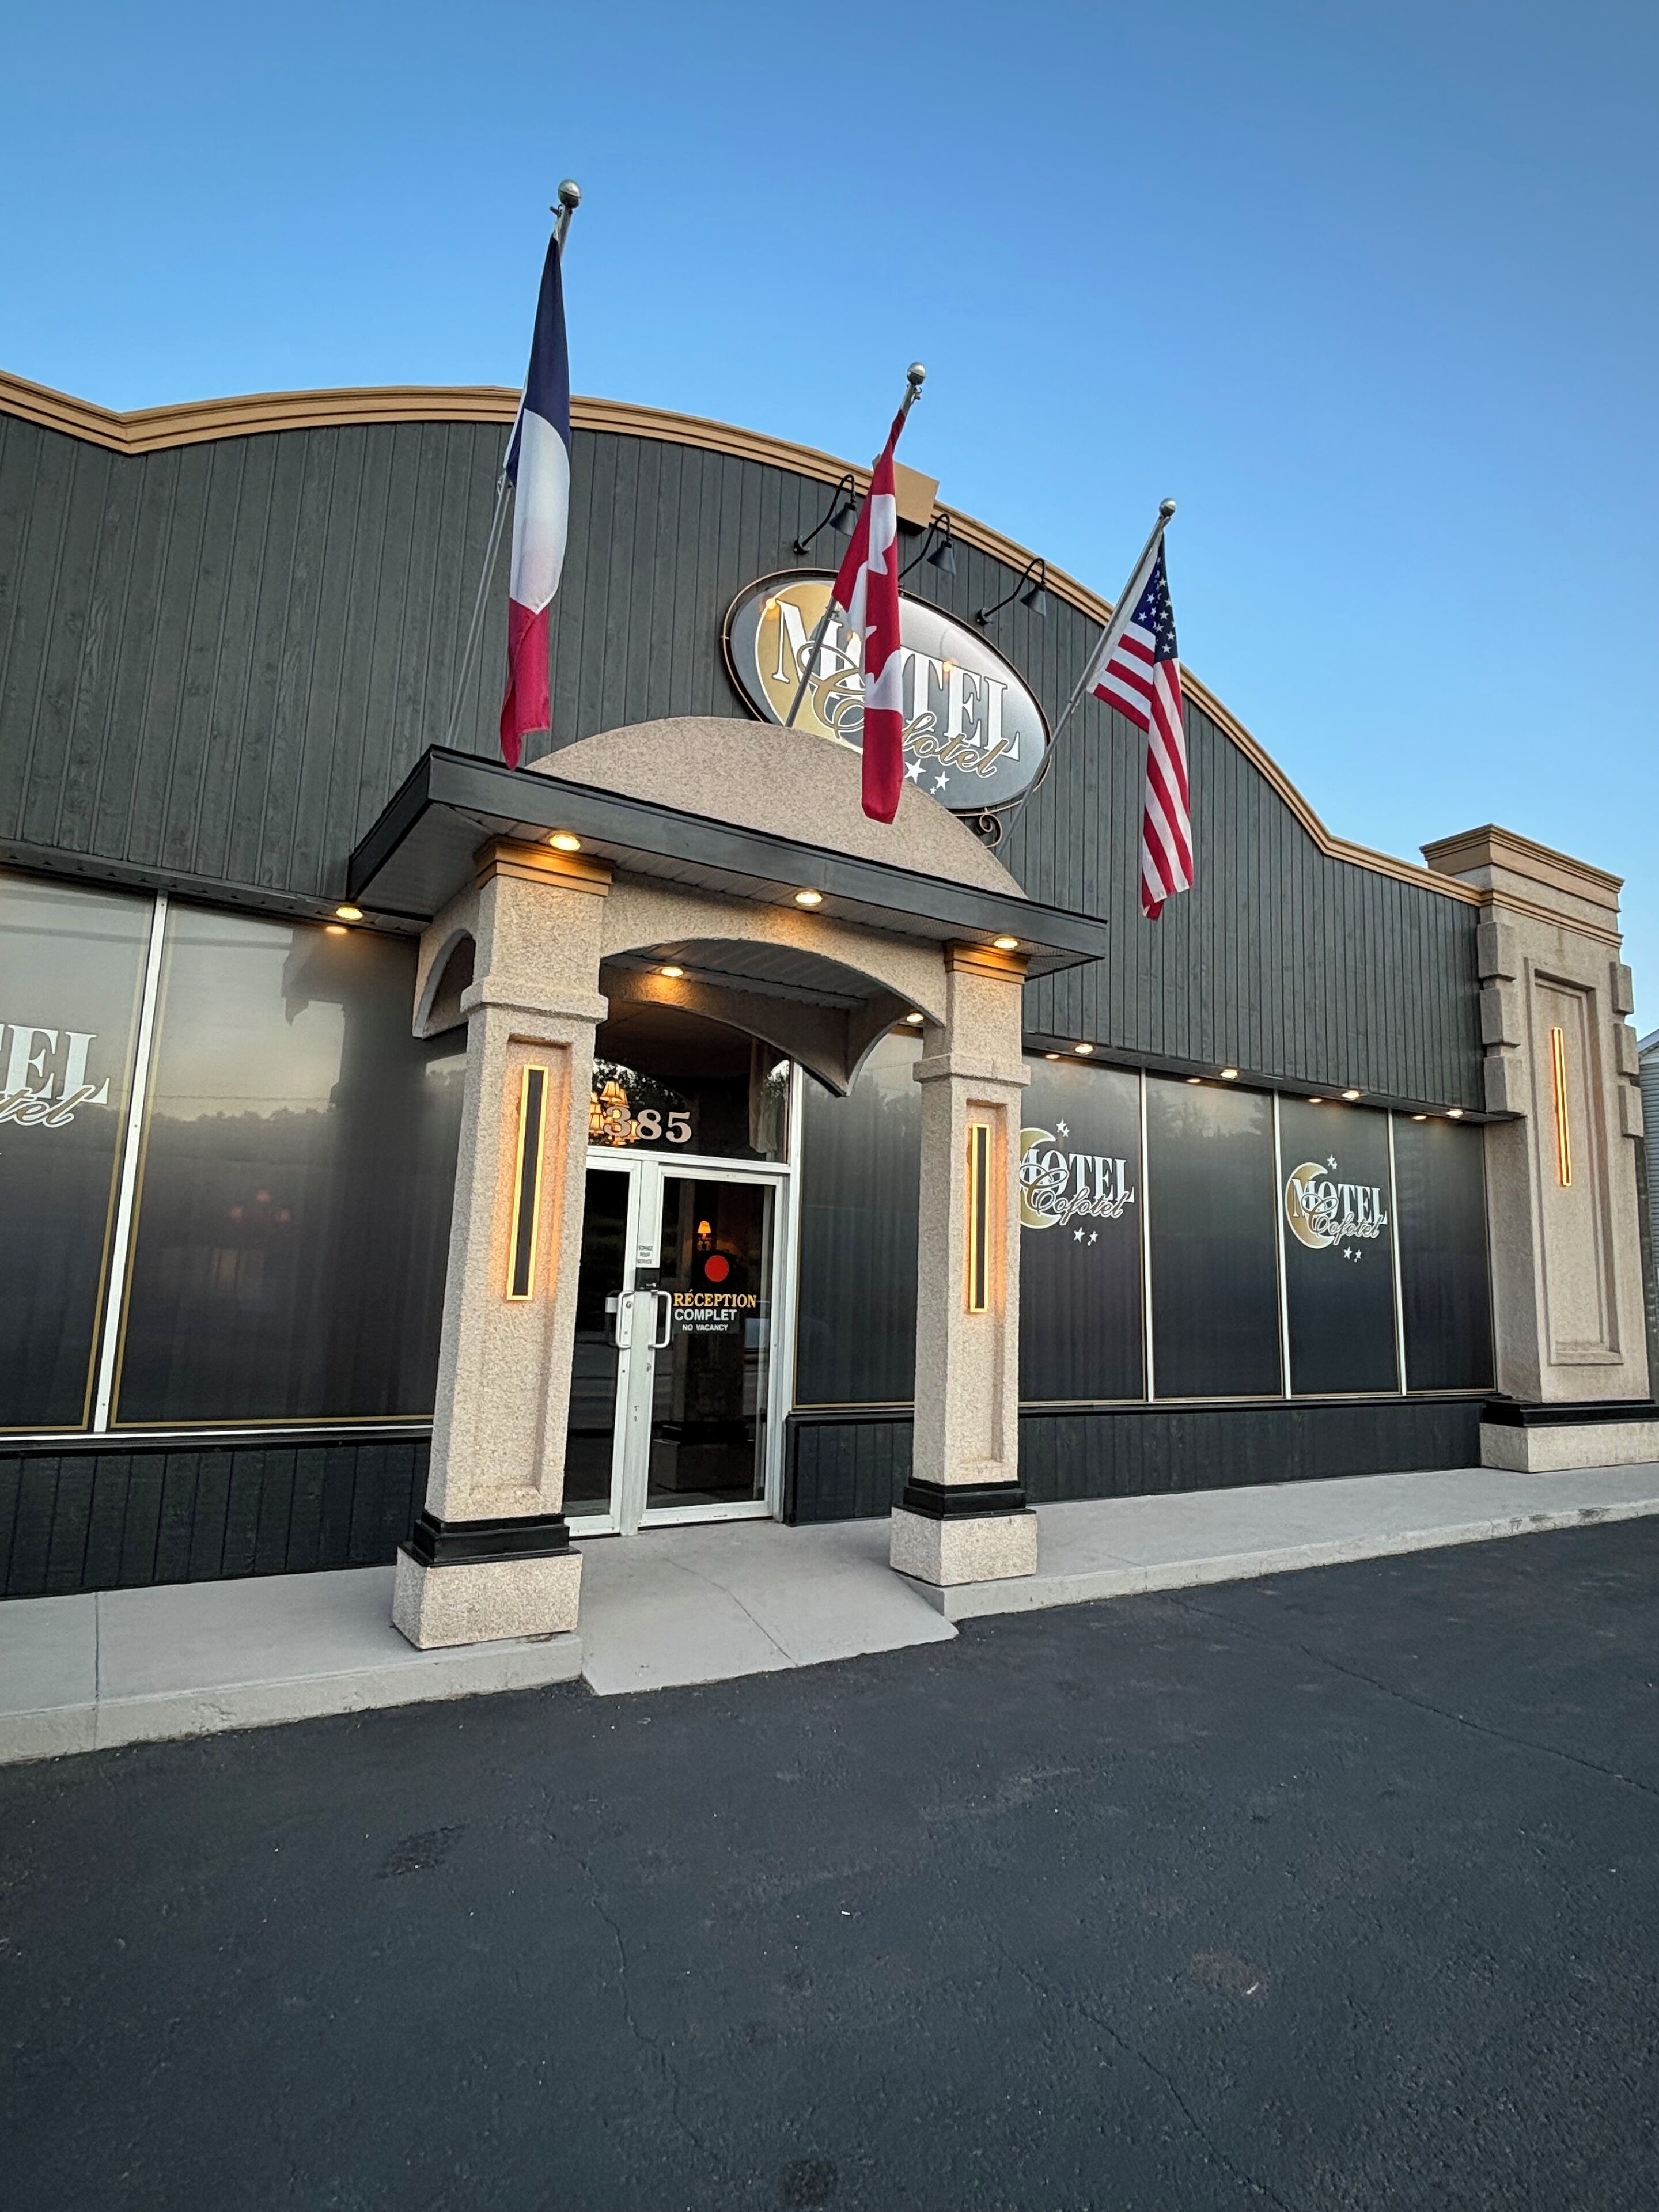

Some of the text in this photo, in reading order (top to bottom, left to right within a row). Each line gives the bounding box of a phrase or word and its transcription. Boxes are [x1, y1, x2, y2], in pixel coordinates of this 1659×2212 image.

[603, 1105, 692, 1143] 385
[1291, 1178, 1388, 1225] MOTEL
[1300, 1192, 1383, 1246] Cofotel
[673, 1288, 757, 1308] RÉCEPTION
[674, 1308, 737, 1321] COMPLET
